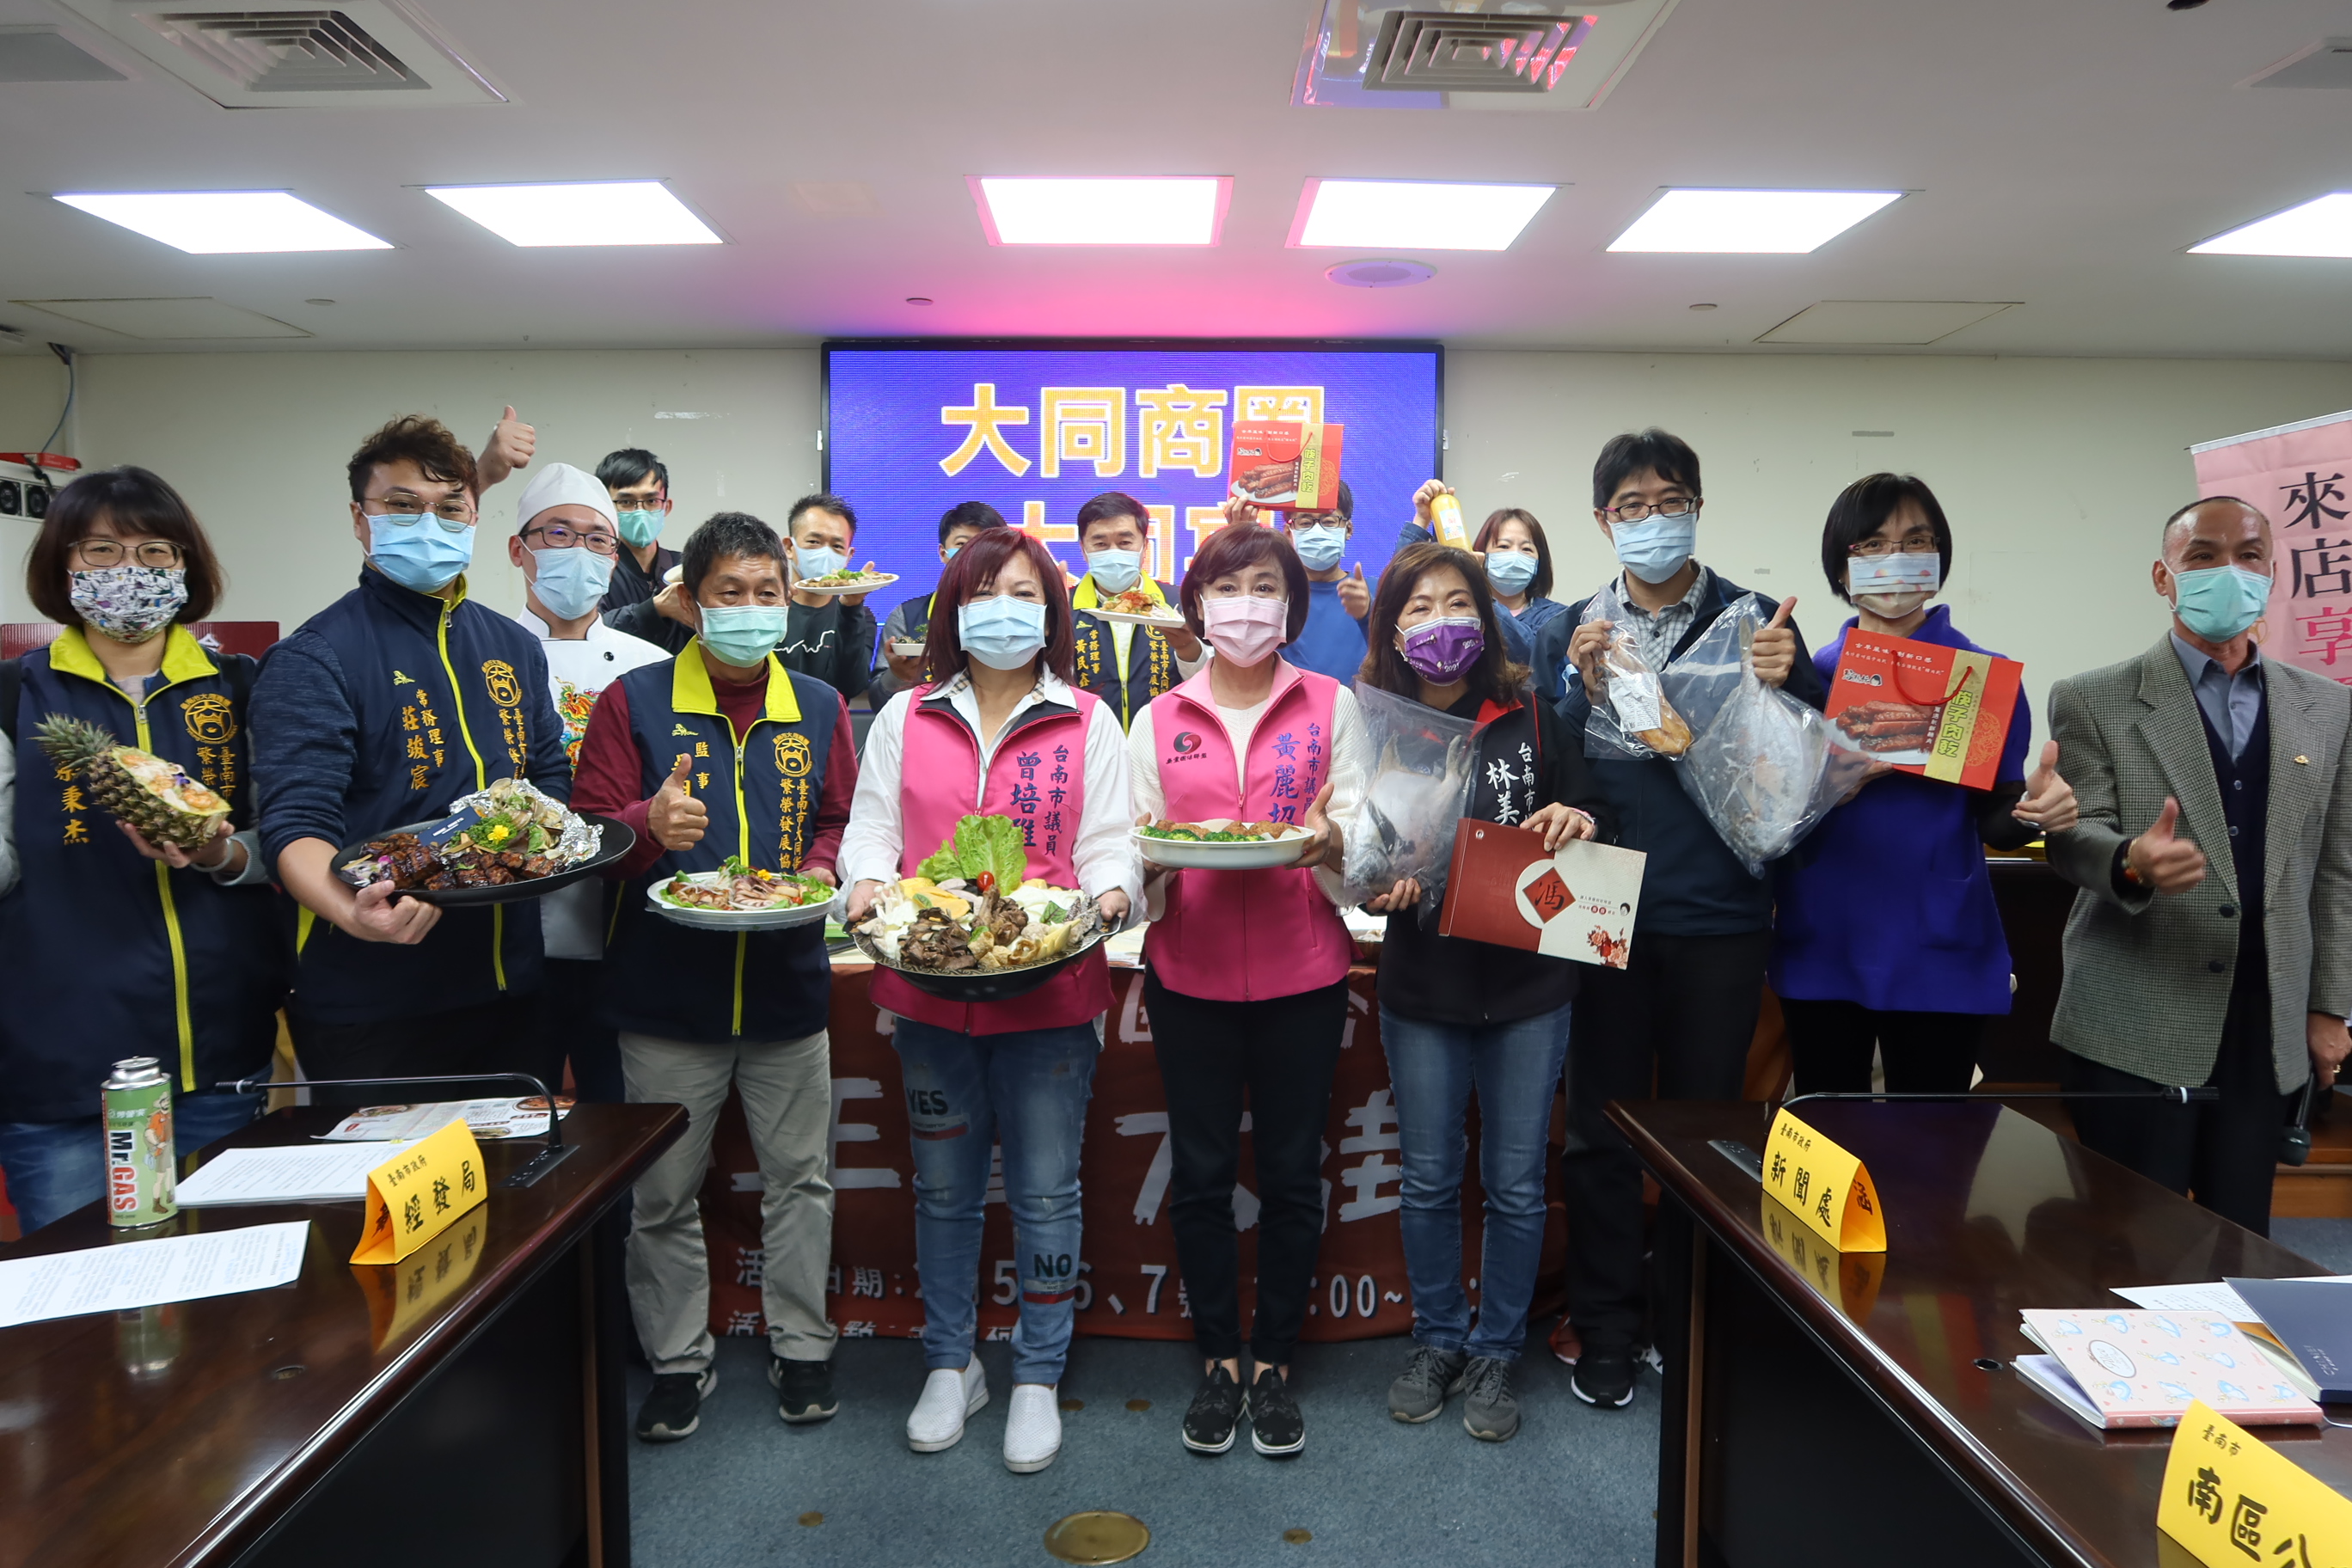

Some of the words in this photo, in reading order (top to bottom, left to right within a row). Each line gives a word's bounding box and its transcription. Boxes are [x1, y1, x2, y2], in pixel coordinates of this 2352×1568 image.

[1301, 448, 1317, 493] 筷子肉乾
[2279, 472, 2352, 686] 來店享
[1089, 629, 1100, 674] 常務理事
[1854, 642, 1890, 654] 古早風味
[416, 689, 445, 768] 常務理事
[1937, 690, 1973, 758] 筷子肉乾
[196, 746, 217, 786] 繁榮
[694, 741, 710, 789] 監事
[1302, 722, 1321, 816] 台南市議員
[1517, 742, 1536, 824] 台南市
[1043, 744, 1069, 856] 台南市議員
[906, 1088, 949, 1115] YES
[1780, 1123, 1812, 1153] 臺南市政府
[109, 1130, 138, 1213] Mr.GAS
[387, 1155, 427, 1187] 臺南市政府
[1771, 1151, 1833, 1228] 新聞處
[404, 1161, 475, 1234] 經發局
[1033, 1253, 1072, 1278] NO
[2202, 1424, 2241, 1456] 臺南市
